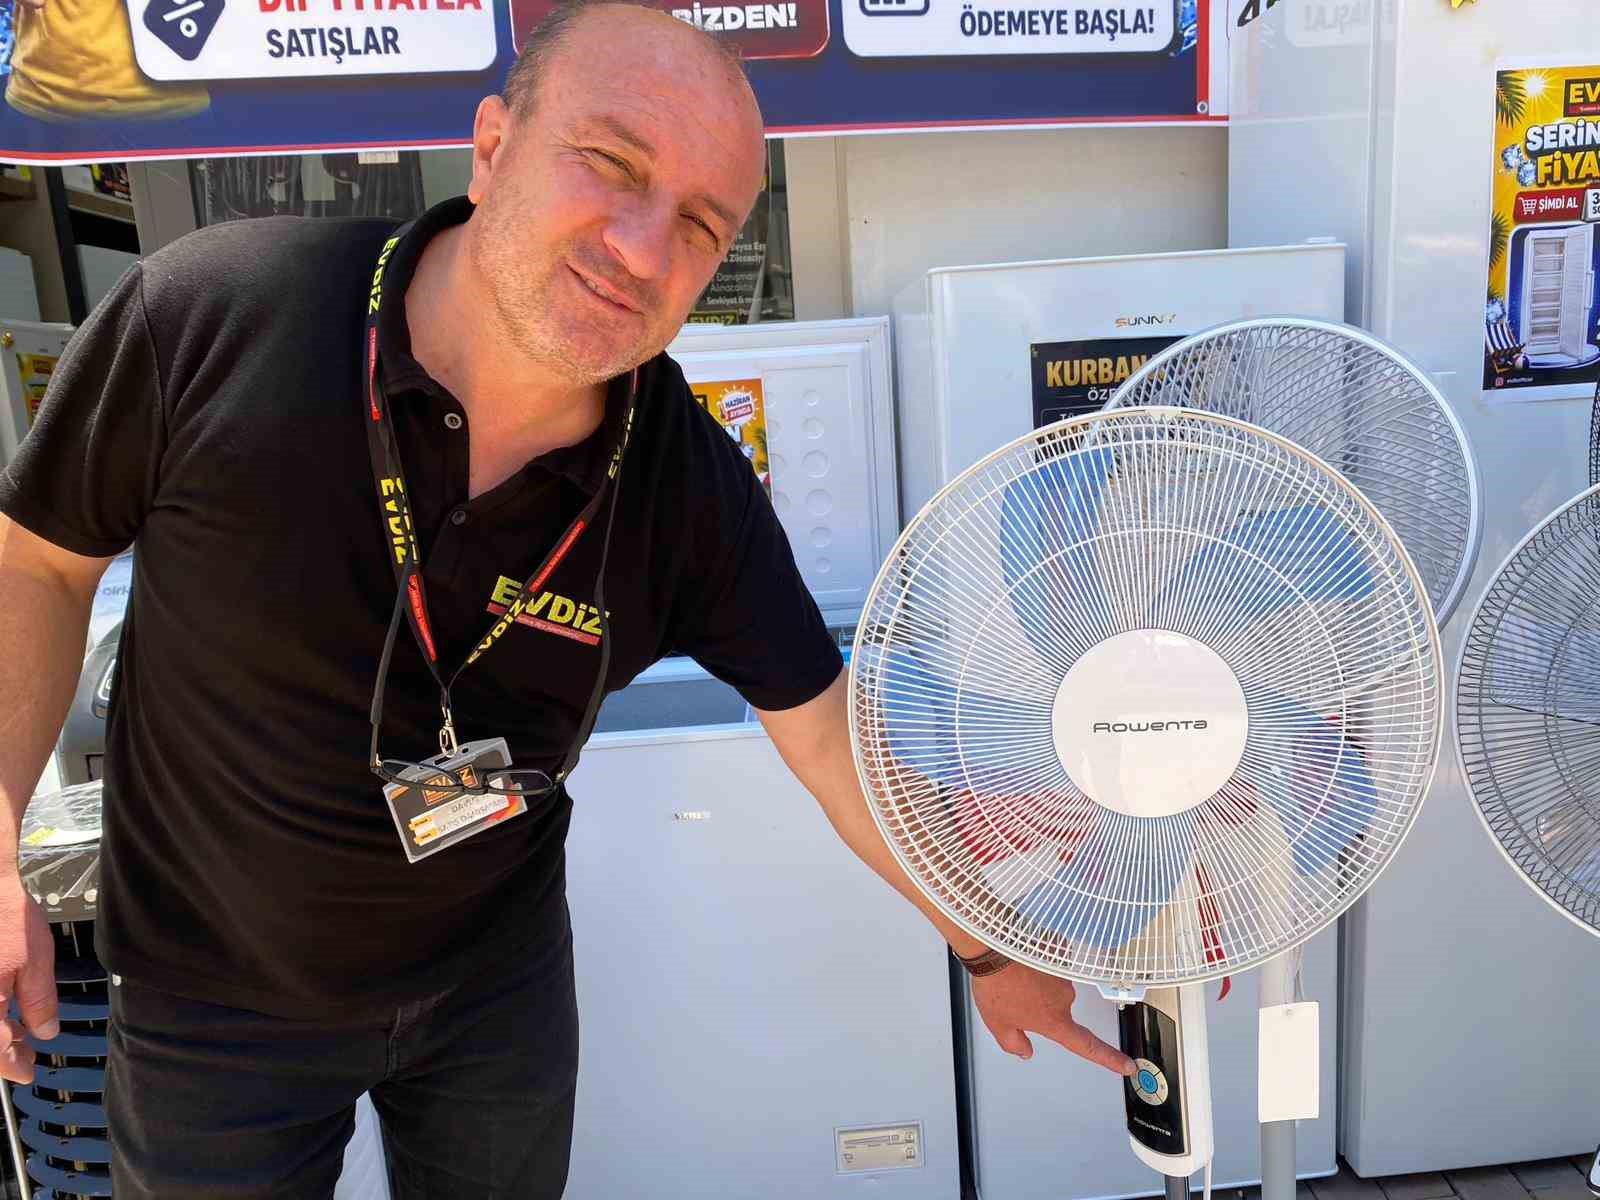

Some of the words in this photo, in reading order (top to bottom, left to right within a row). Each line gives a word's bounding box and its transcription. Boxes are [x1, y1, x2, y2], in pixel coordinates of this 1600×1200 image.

[960, 5, 1067, 37] ÖDEMEYE
[1075, 9, 1155, 41] BAŞLA!
[266, 26, 400, 63] SATIŞLAR
[1539, 194, 1565, 213] ŞİMDİ
[1566, 196, 1578, 209] AL
